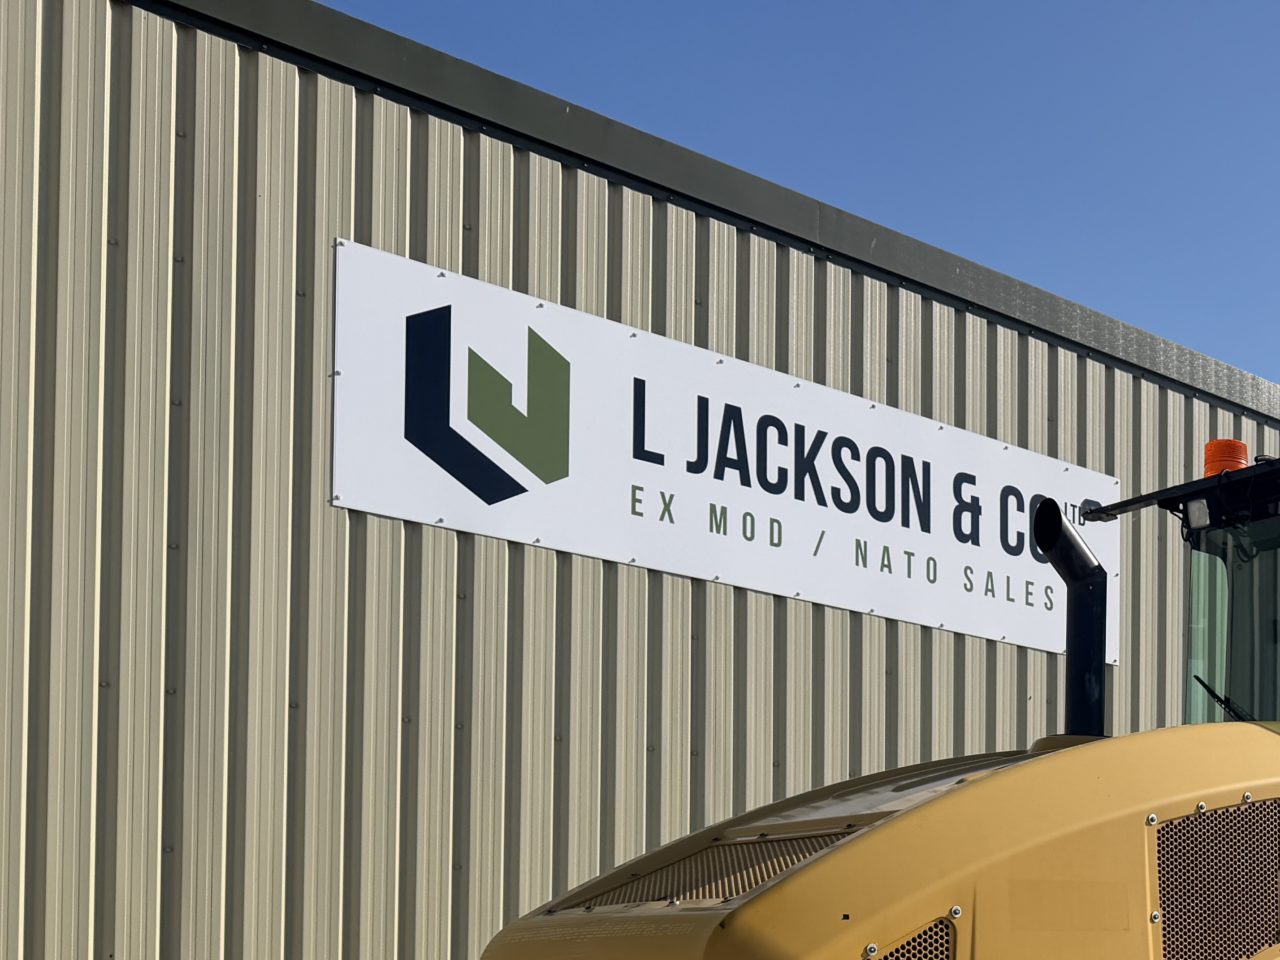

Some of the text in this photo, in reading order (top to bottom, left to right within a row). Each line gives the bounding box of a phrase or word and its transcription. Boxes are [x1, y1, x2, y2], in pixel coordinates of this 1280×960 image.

[632, 376, 665, 466] L
[686, 394, 931, 534] JACKSON
[953, 471, 982, 547] &
[631, 484, 1054, 611] EX MOD / NATO SALES
